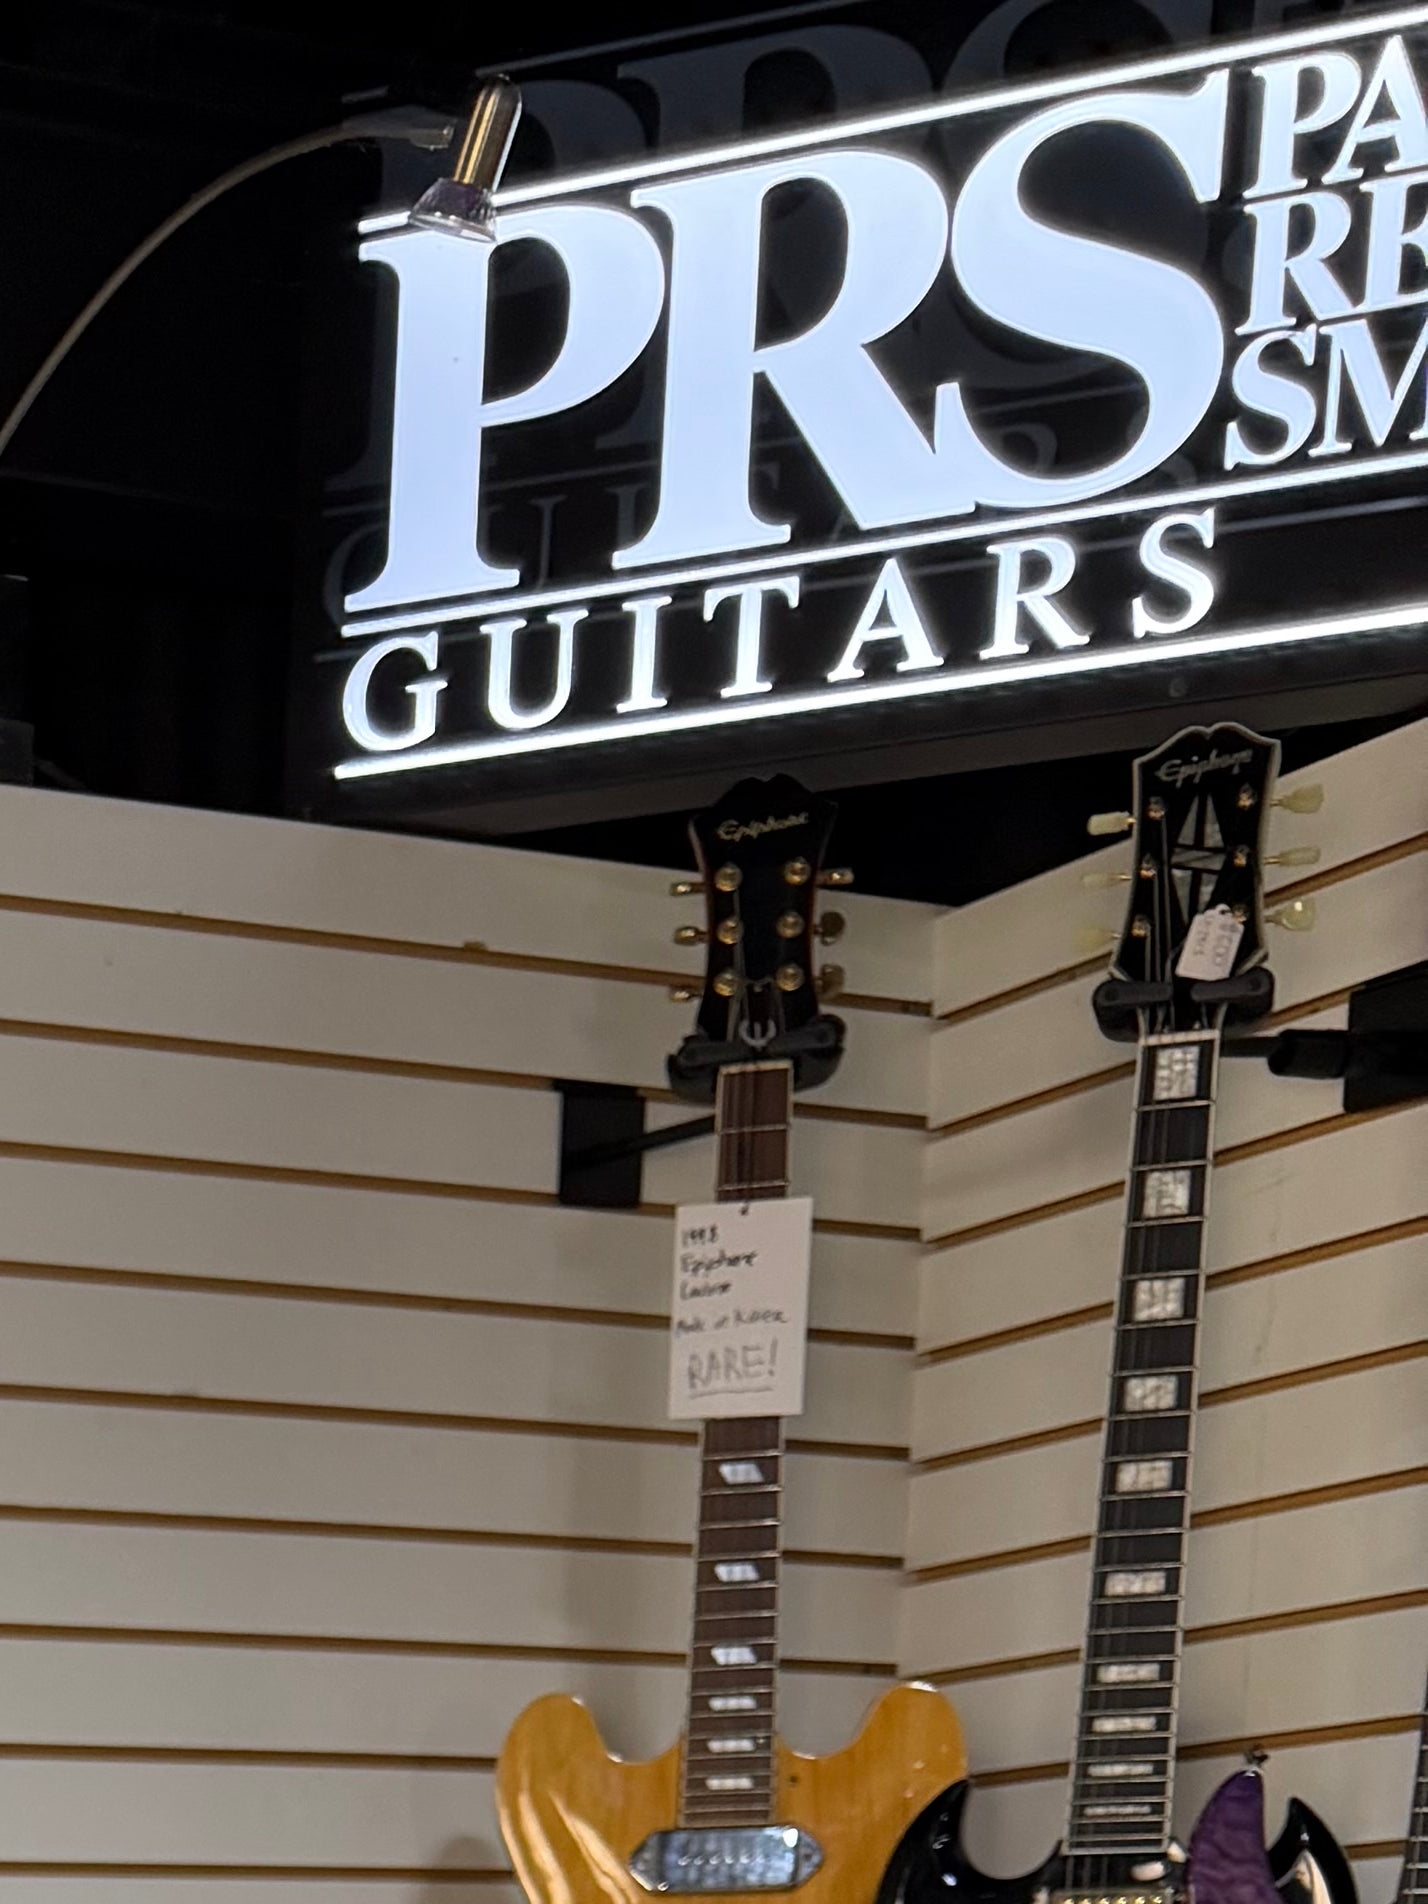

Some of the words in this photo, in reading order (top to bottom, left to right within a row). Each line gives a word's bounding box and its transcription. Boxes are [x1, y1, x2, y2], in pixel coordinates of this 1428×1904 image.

[1243, 35, 1428, 198] PA
[344, 75, 1225, 612] PRS
[344, 507, 1217, 752] GUITARS
[1154, 748, 1254, 789] Epiphone
[687, 1338, 779, 1390] RARE!
